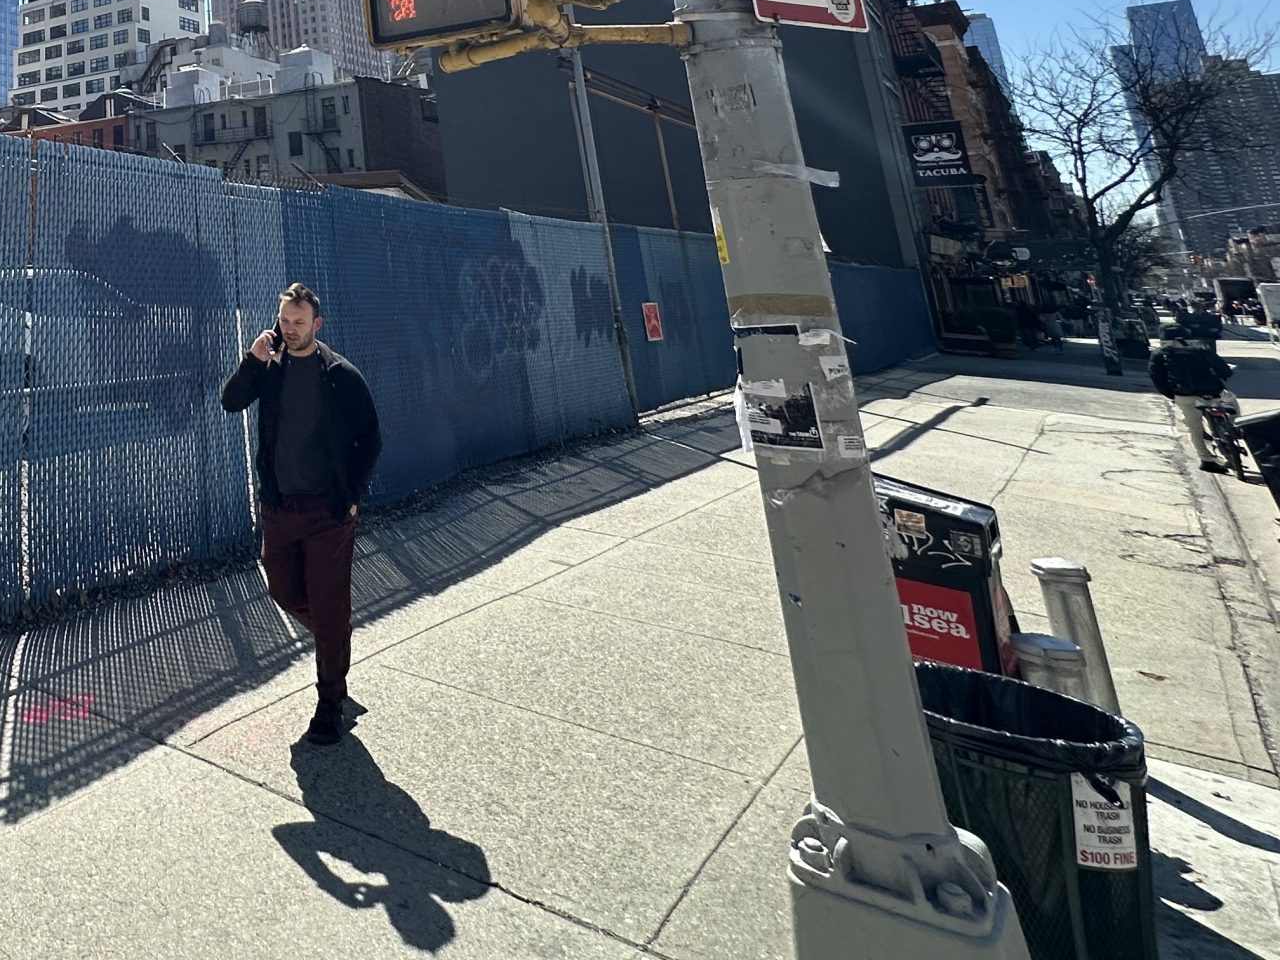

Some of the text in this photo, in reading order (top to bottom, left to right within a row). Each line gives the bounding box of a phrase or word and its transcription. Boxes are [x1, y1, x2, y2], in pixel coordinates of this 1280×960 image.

[916, 167, 968, 177] TACUBA
[911, 603, 958, 623] now
[900, 604, 970, 639] lsea
[1075, 800, 1088, 809] NO
[1096, 811, 1120, 820] TRASH
[1083, 824, 1131, 835] NO BUSINESS
[1097, 835, 1122, 844] TRASH
[1080, 850, 1135, 865] $100 FINE
